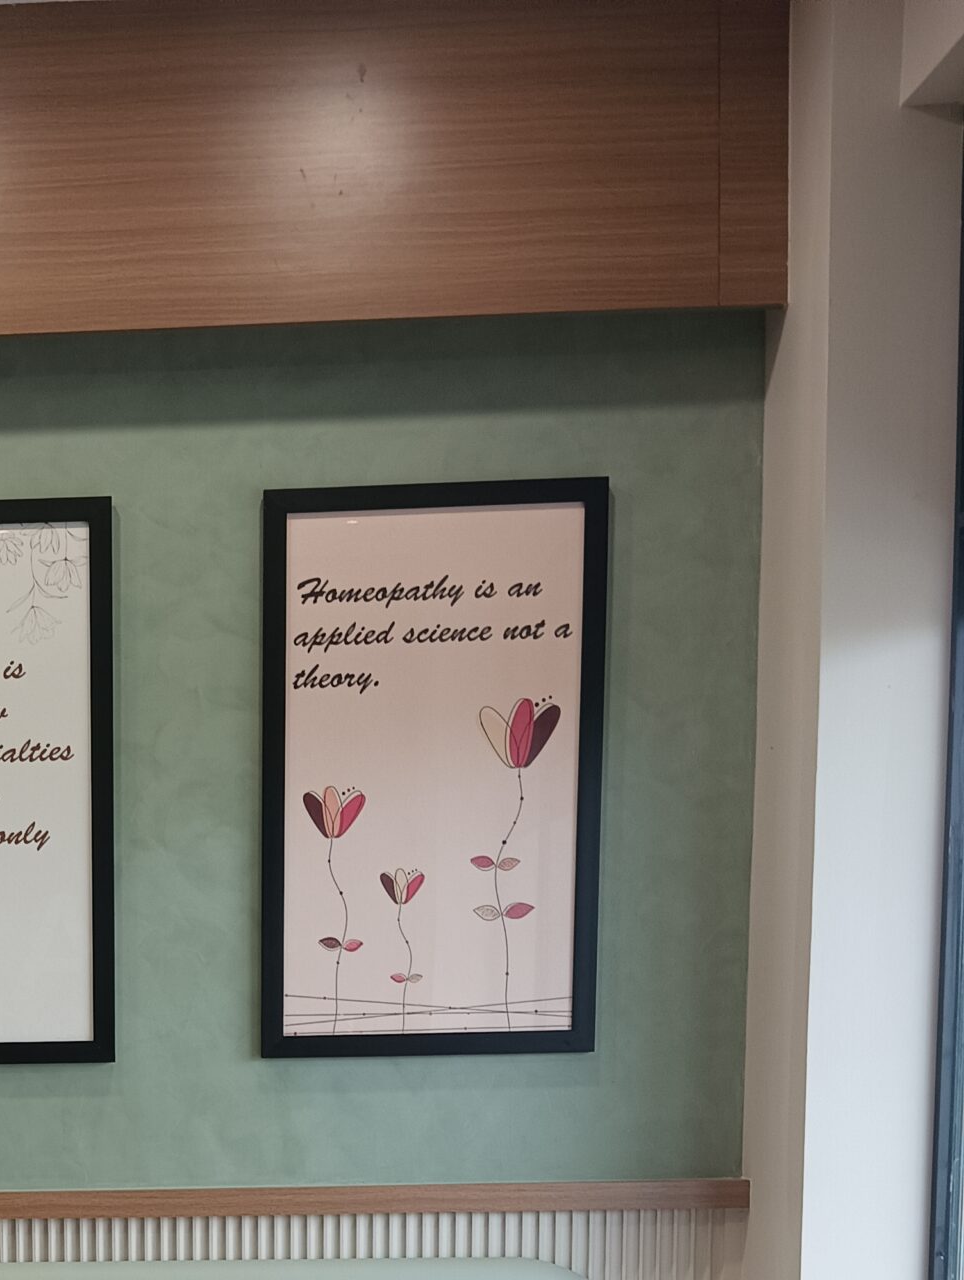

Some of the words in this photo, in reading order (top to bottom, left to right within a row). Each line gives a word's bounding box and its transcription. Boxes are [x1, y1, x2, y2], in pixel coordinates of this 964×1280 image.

[297, 575, 464, 608] Homeopathy
[474, 580, 497, 599] is
[508, 582, 542, 598] an
[293, 621, 395, 653] applied
[402, 623, 492, 643] science
[503, 620, 546, 640] not
[554, 623, 573, 639] a
[3, 660, 25, 679] is
[293, 664, 380, 694] theory.
